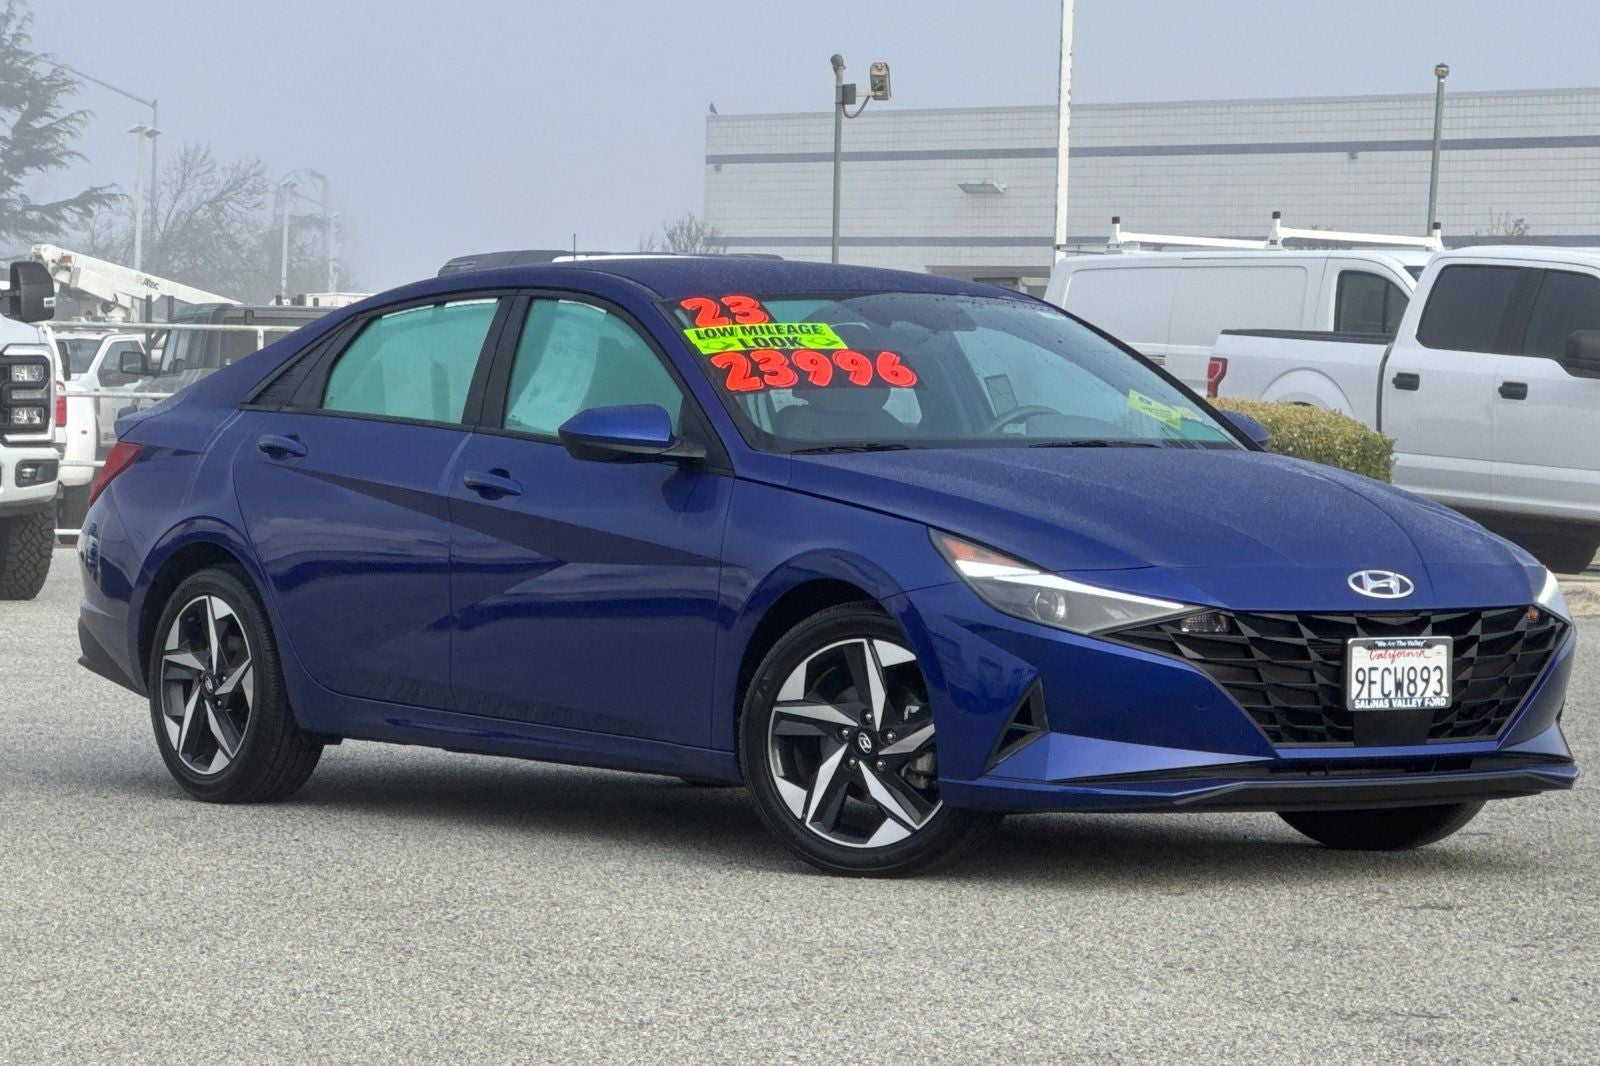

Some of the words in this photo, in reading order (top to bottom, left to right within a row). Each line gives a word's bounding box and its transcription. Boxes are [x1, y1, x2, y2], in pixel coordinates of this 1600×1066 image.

[681, 295, 769, 327] 23
[694, 327, 735, 341] LOW
[740, 324, 820, 336] MILEAGE
[738, 336, 804, 349] LOOK
[711, 349, 918, 392] 23996
[1369, 649, 1432, 665] California
[1355, 665, 1444, 699] 9FCW893
[1392, 698, 1422, 708] VALLEY
[1424, 697, 1447, 707] FORD
